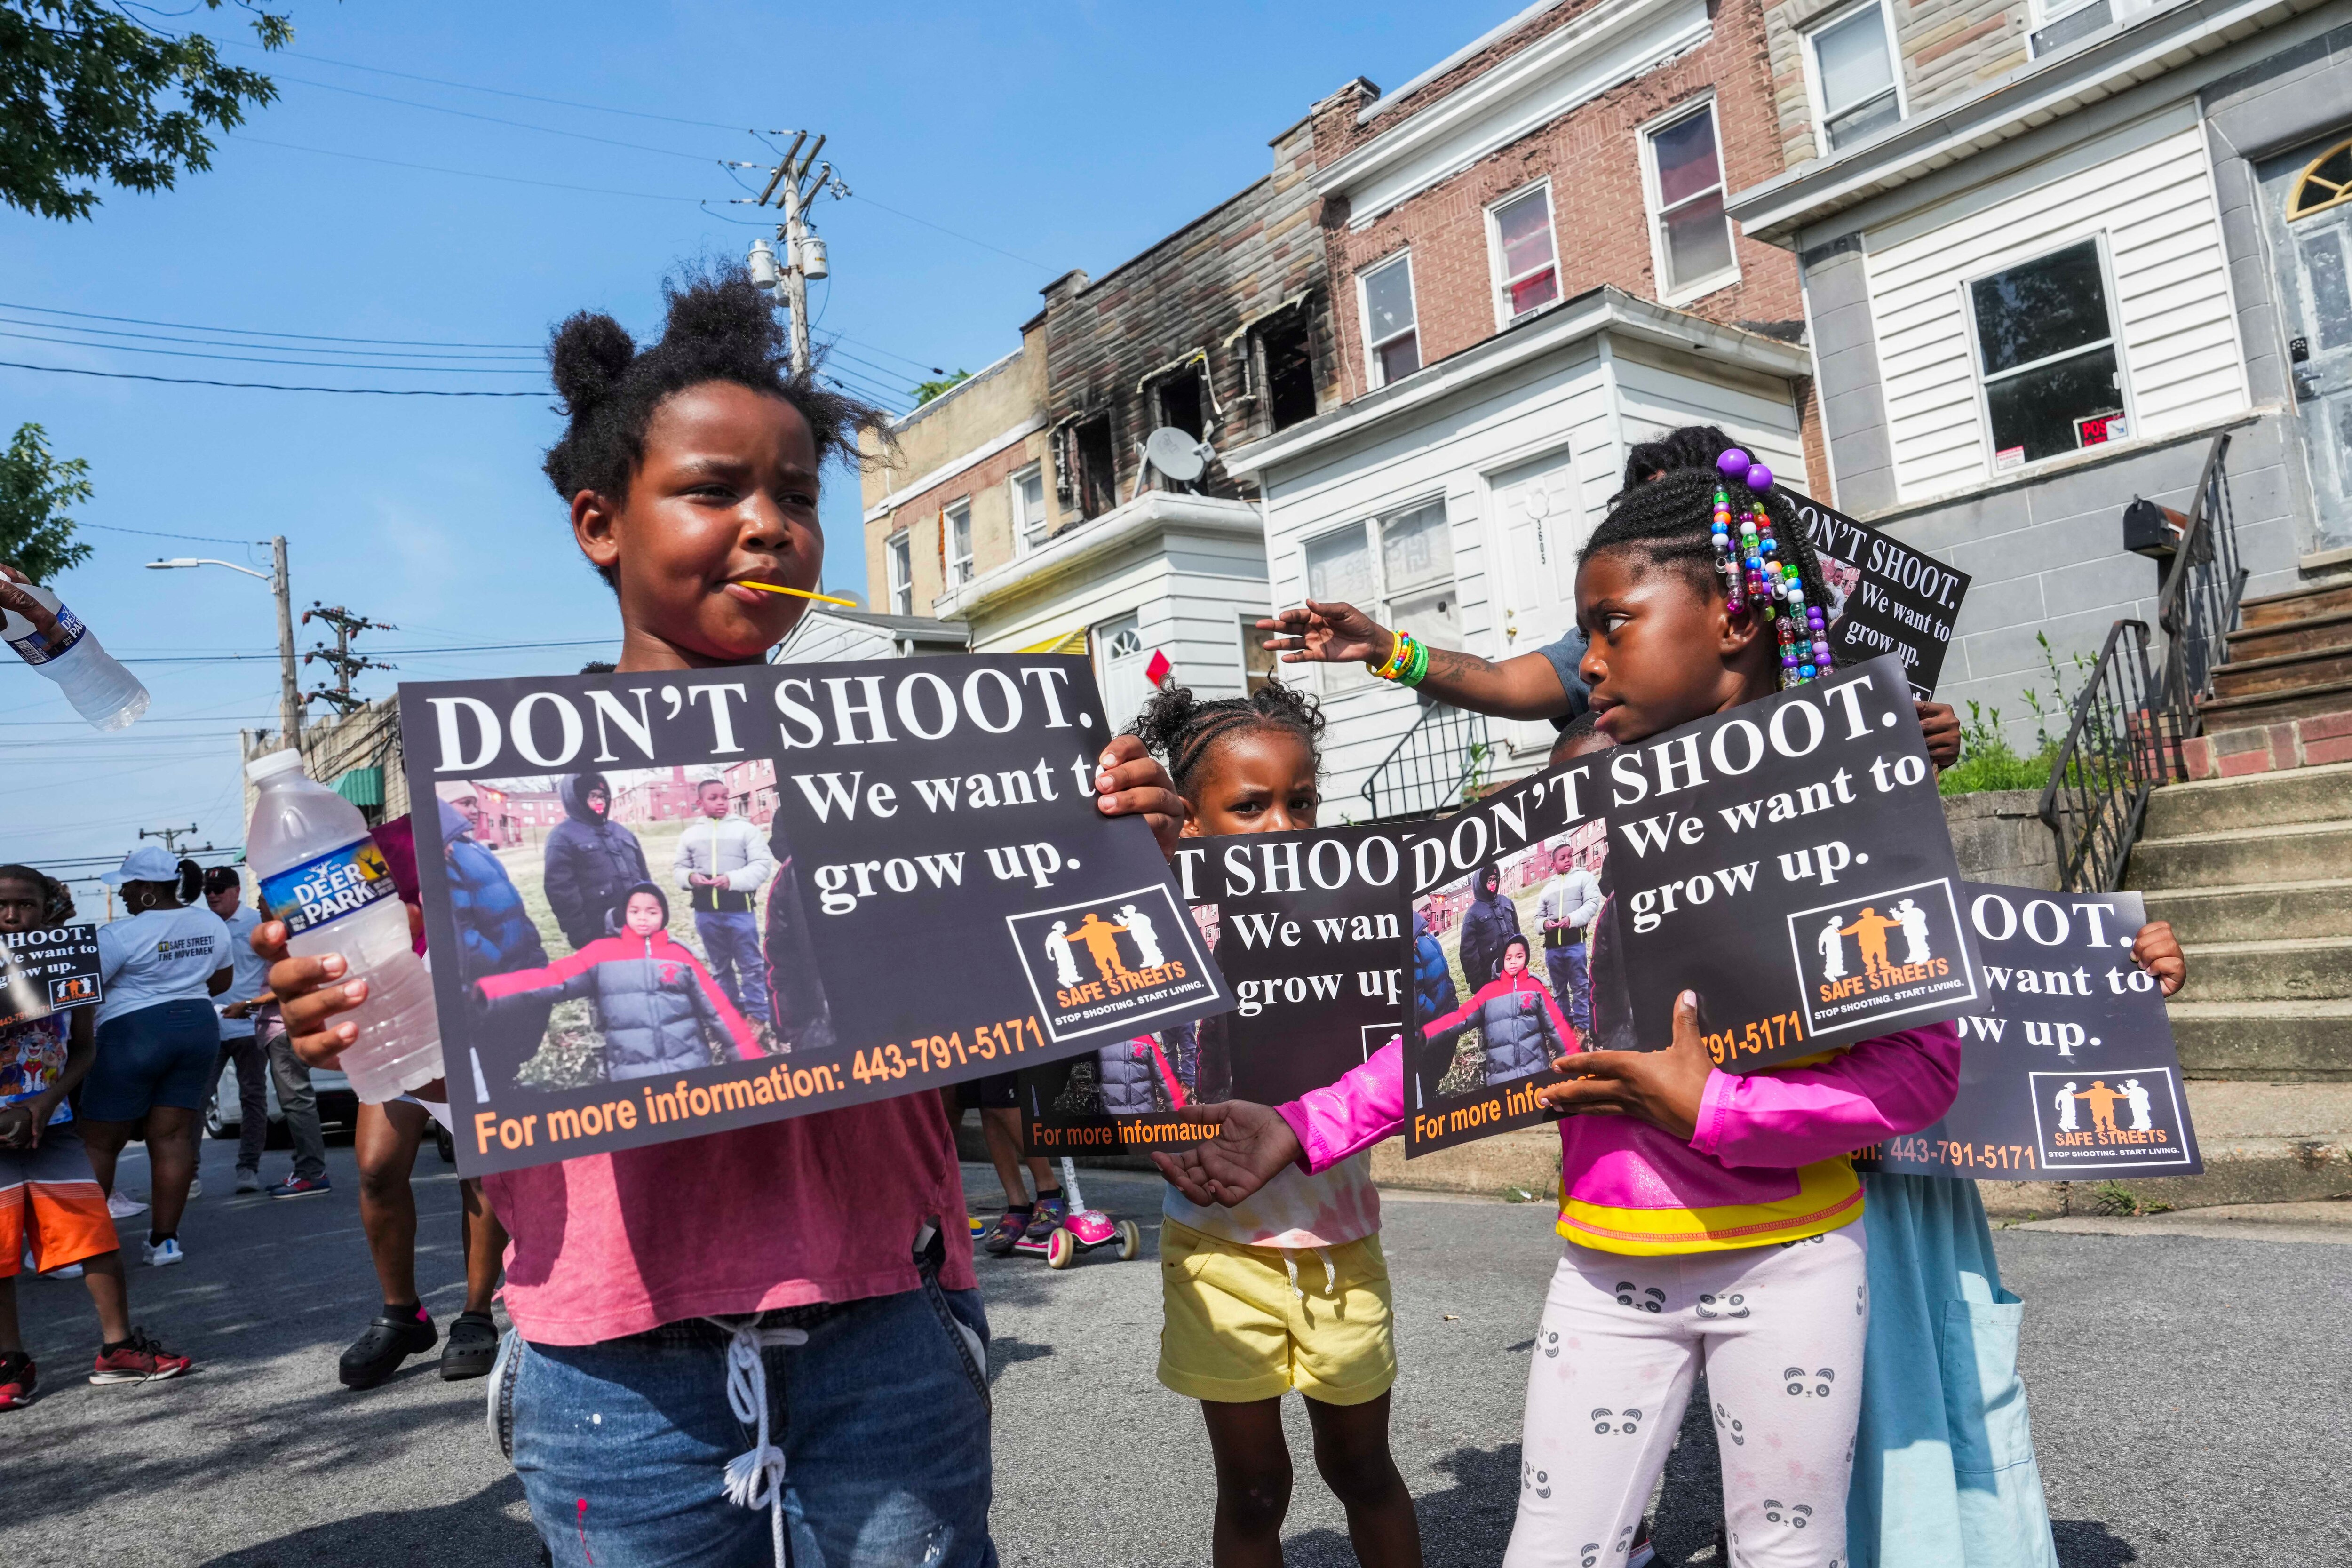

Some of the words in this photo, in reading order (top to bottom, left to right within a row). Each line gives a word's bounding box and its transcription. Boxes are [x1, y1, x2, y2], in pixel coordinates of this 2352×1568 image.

[1537, 519, 1546, 565] 3605
[1780, 493, 1867, 563] ON'T
[1867, 539, 1959, 610] SHOOT.
[61, 612, 77, 631] DEE
[68, 618, 85, 639] PAR
[1862, 580, 1889, 613] We
[1894, 600, 1931, 633] want
[1934, 618, 1950, 642] to
[1844, 621, 1894, 653] grow
[1898, 642, 1919, 668] up.
[426, 683, 747, 772] DON'T
[774, 667, 1093, 749] SHOOT.
[791, 771, 898, 823] We
[911, 757, 1058, 813] want
[1410, 765, 1591, 894] DON'T
[1611, 675, 1898, 808] SHOOT.
[1619, 811, 1705, 859] We
[1718, 767, 1857, 834] want
[1869, 755, 1926, 794] to
[293, 863, 366, 906] DEER
[814, 851, 966, 915] grow
[984, 842, 1081, 888] up.
[1223, 836, 1400, 898] SHOO
[1630, 861, 1761, 934] grow
[1777, 840, 1869, 886] up.
[302, 880, 376, 925] PARK
[1971, 893, 2132, 948] OOT.
[159, 947, 172, 962] THE
[175, 945, 215, 959] MOVEMEN
[170, 939, 185, 950] SAFE
[187, 935, 215, 947] STREET
[1230, 912, 1301, 951] We
[1312, 912, 1401, 944] wan
[0, 953, 24, 968] We
[28, 945, 75, 960] want
[79, 944, 97, 954] to
[47, 962, 77, 974] up.
[1057, 981, 1106, 1008] SAFE
[1107, 961, 1187, 995] STREETS
[1236, 973, 1343, 1017] grow
[1357, 968, 1402, 1005] up
[1814, 1007, 1839, 1020] STOP
[1840, 995, 1893, 1013] SHOOTING.
[1894, 986, 1926, 1001] START
[1927, 979, 1964, 994] LIVING.
[1820, 976, 1866, 1002] SAFE
[1868, 957, 1950, 990] STREETS
[1983, 966, 2092, 995] want
[2106, 966, 2154, 993] to
[1055, 1012, 1081, 1026] STOP
[1082, 999, 1137, 1019] SHOOTING.
[1137, 989, 1168, 1004] START
[1170, 980, 1204, 995] LIVING.
[2022, 1021, 2101, 1057] up.
[474, 1111, 537, 1154] For
[547, 1099, 638, 1142] more
[644, 1063, 846, 1125] information:
[852, 1015, 1045, 1084] 443-791-5171
[1033, 1122, 1062, 1146] For
[1067, 1127, 1112, 1145] more
[1414, 1114, 1446, 1144] For
[1450, 1099, 1501, 1132] more
[2054, 1131, 2094, 1146] SAFE
[2098, 1129, 2168, 1146] STREETS
[1890, 1136, 2036, 1170] 443-791-5171
